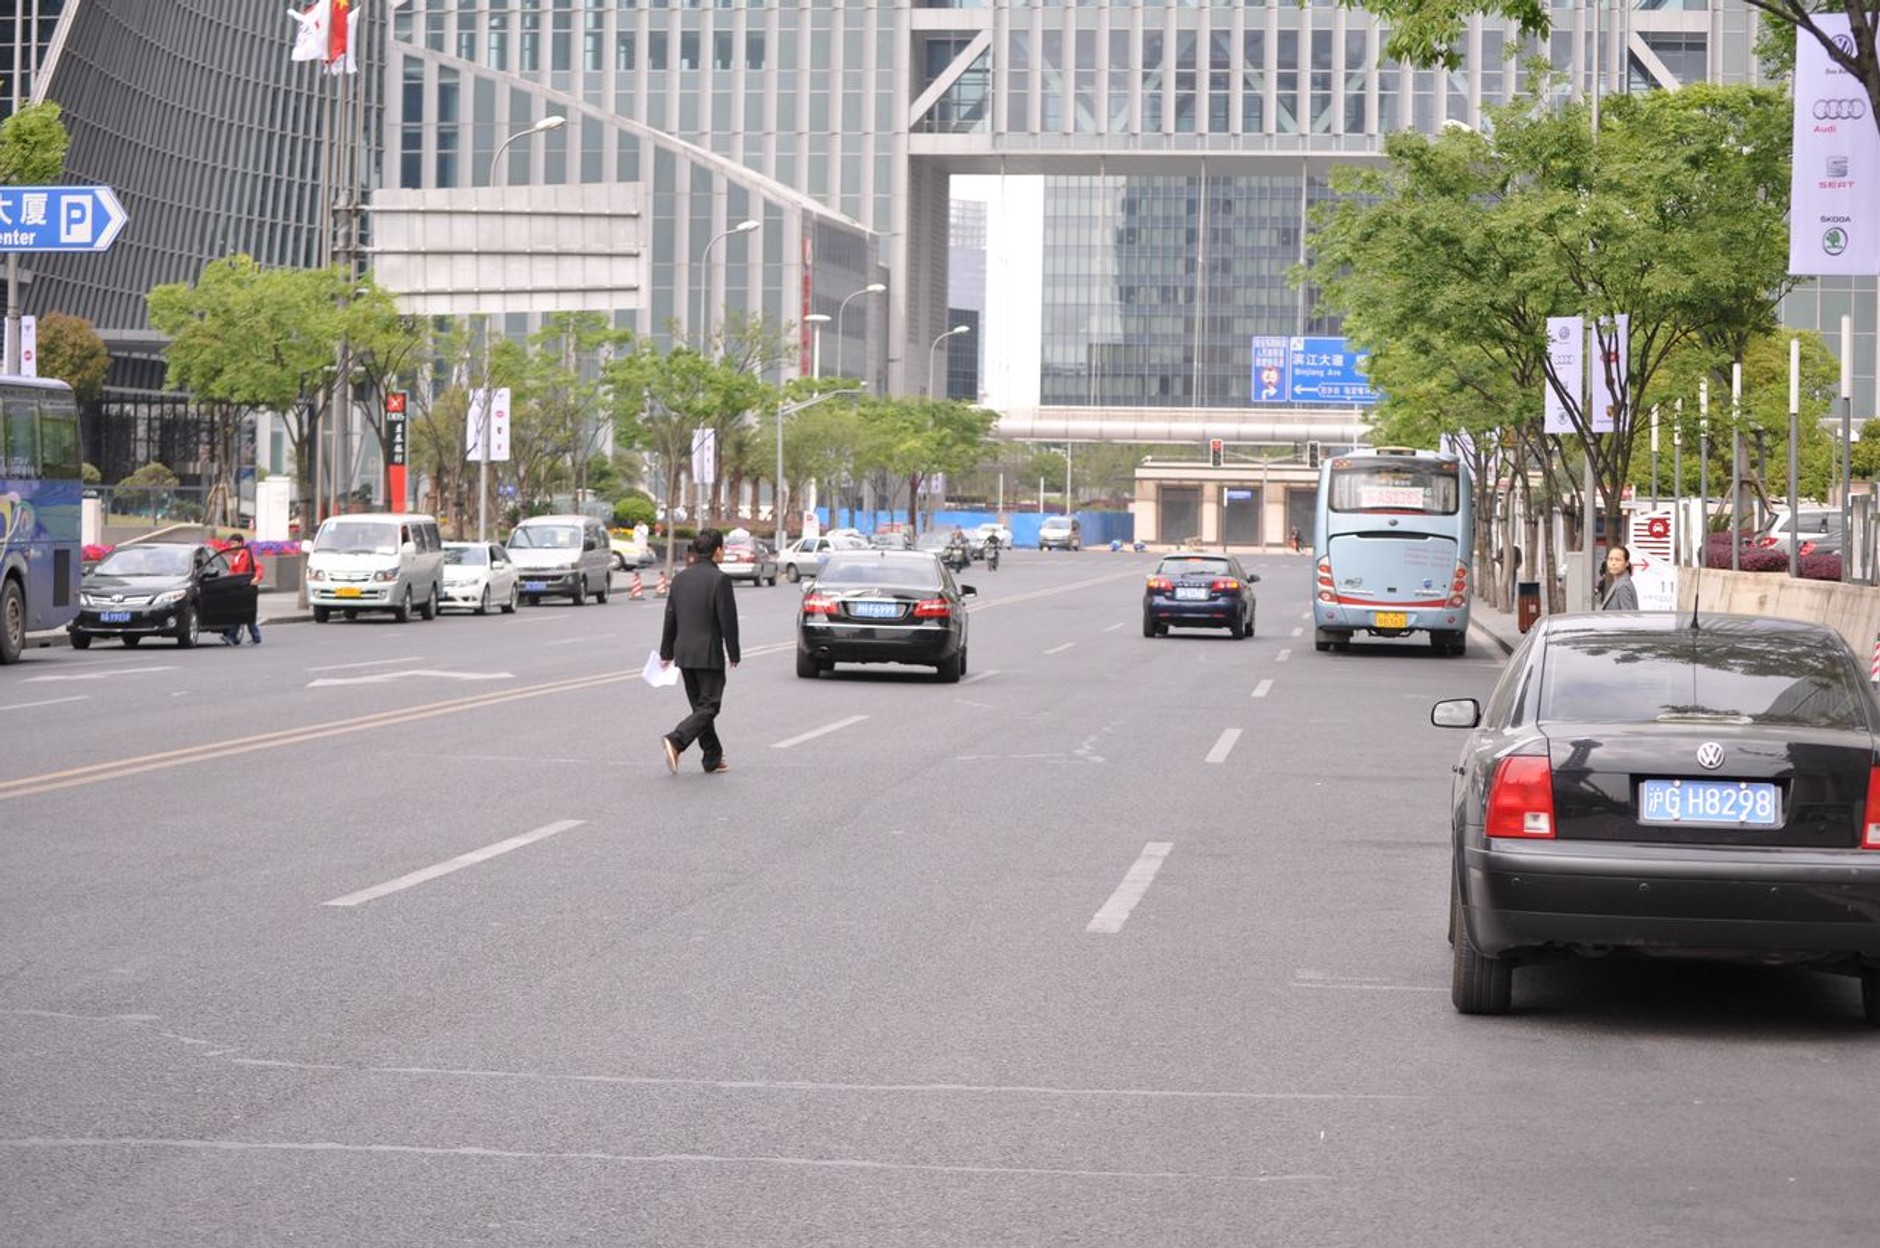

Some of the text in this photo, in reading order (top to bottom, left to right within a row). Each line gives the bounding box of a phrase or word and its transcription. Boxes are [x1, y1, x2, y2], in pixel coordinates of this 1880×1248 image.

[1813, 125, 1837, 134] Audi
[1818, 181, 1855, 189] SEAT
[0, 229, 36, 246] nter
[1292, 353, 1344, 367] 滨江大道
[1687, 787, 1771, 816] H8298
